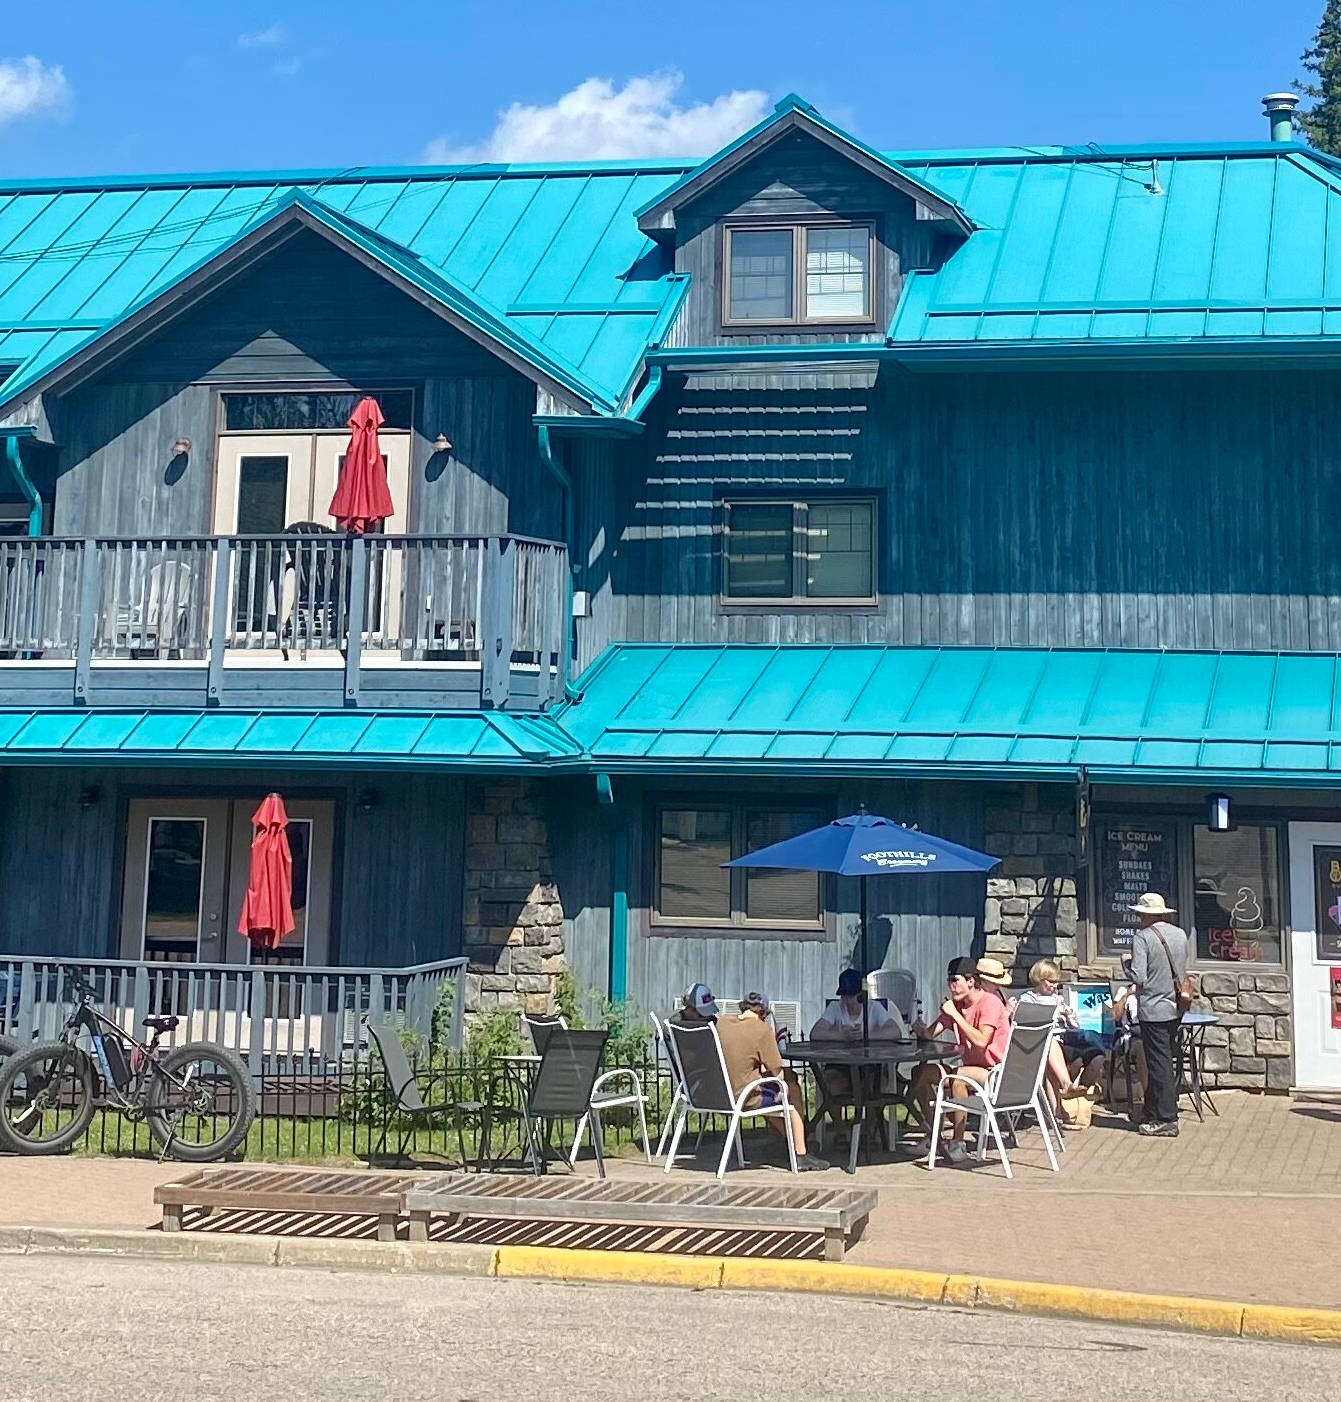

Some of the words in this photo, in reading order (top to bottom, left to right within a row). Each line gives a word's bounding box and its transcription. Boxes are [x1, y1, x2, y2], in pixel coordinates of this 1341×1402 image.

[1107, 830, 1124, 841] ICE
[1127, 831, 1162, 842] CREAM
[1121, 841, 1148, 852] MENU
[1118, 860, 1152, 870] SUNDAES
[1121, 871, 1150, 880] SHAKES
[1123, 882, 1148, 891] MALTS
[1114, 892, 1142, 901] SMOOT
[1209, 927, 1234, 942] Ice
[1112, 937, 1132, 945] WAFF
[1208, 941, 1264, 959] Cream
